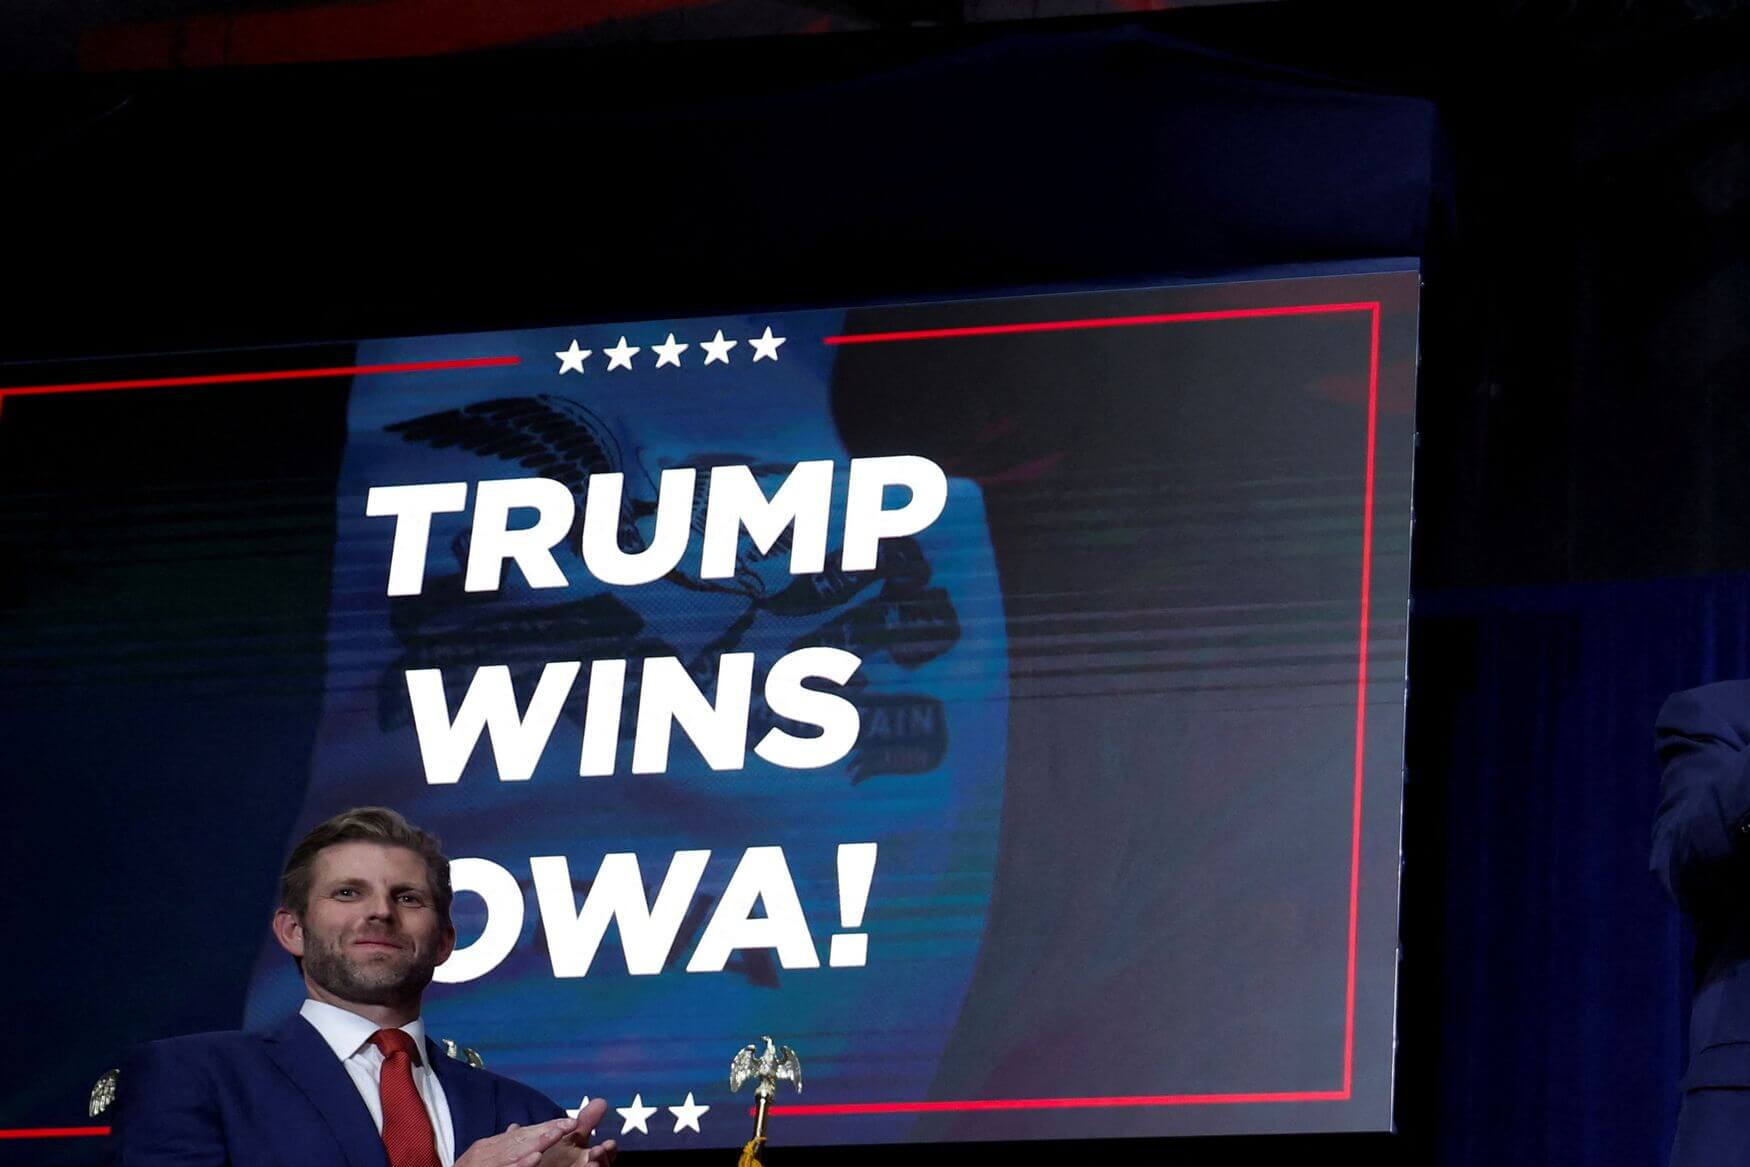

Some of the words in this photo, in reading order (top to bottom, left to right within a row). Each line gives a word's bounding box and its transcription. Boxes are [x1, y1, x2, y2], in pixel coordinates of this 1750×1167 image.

[365, 454, 949, 597] TRUMP
[404, 645, 863, 786] WINS
[431, 841, 879, 984] OWA!
